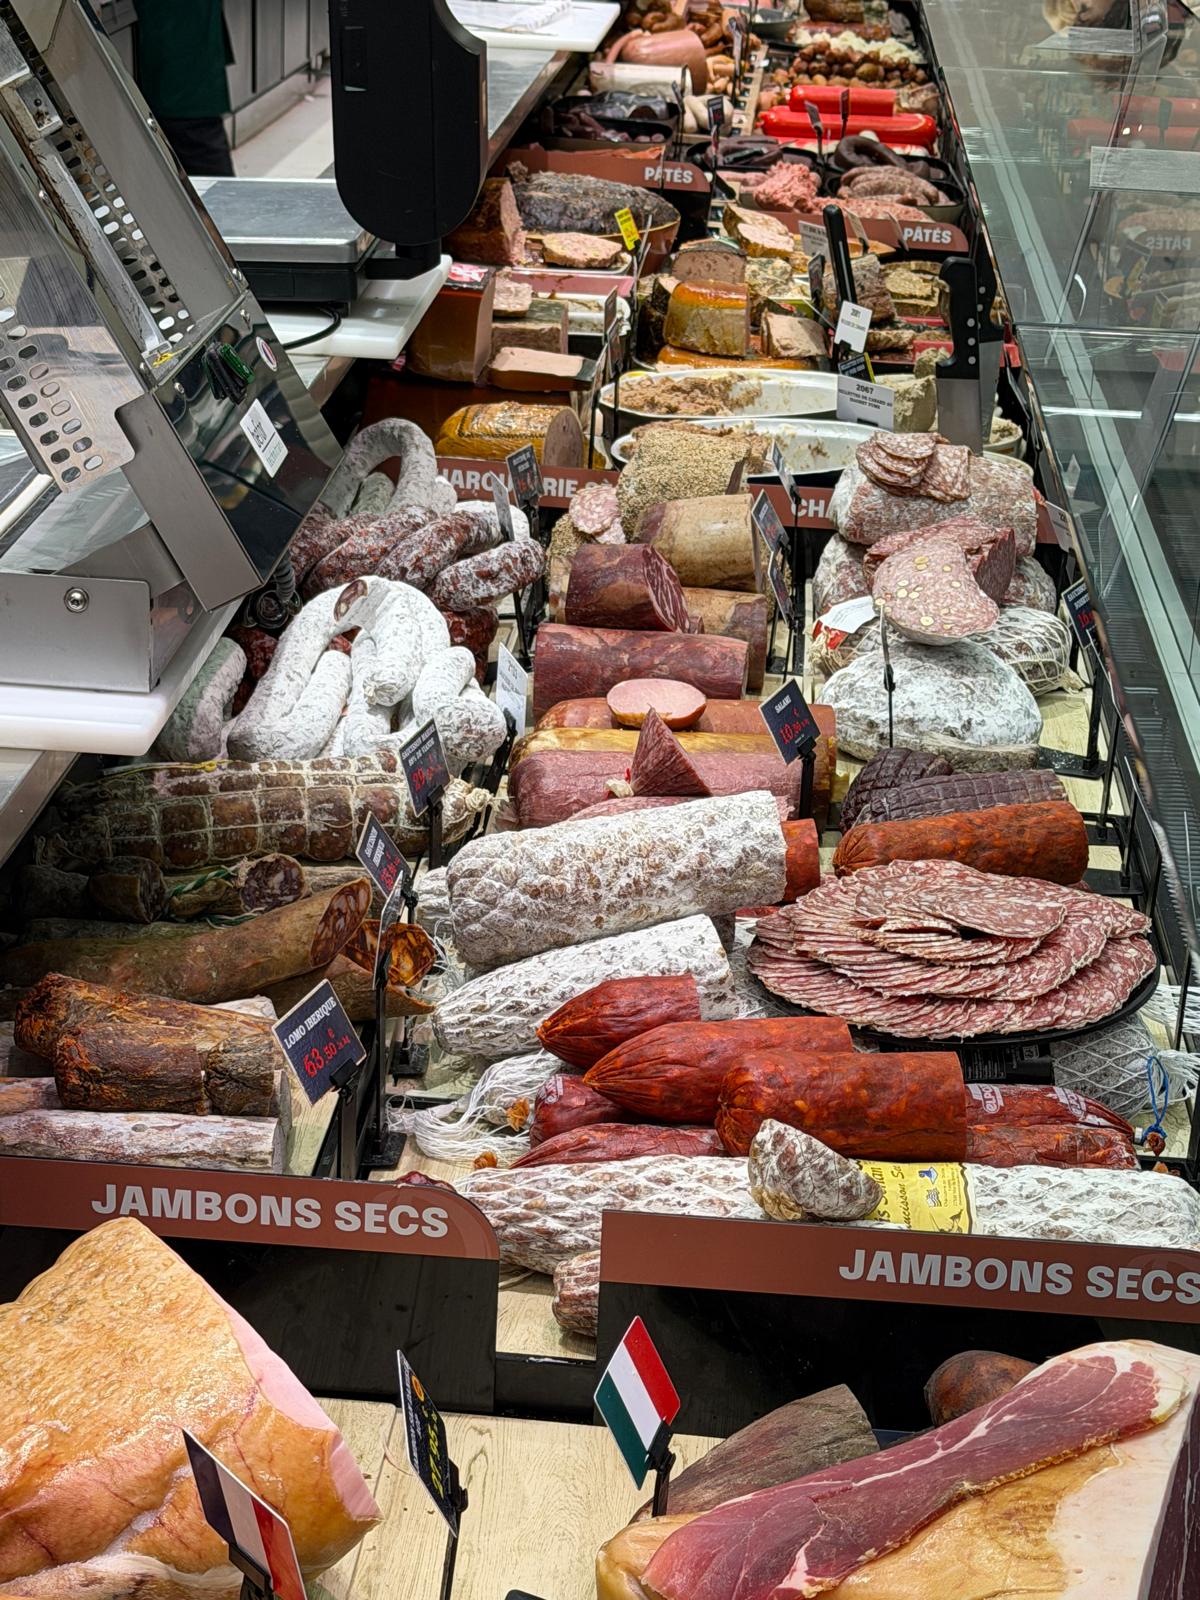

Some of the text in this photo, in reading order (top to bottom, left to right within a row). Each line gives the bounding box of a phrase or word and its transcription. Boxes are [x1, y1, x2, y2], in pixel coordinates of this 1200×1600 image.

[644, 165, 693, 184] PÂTÉS
[903, 225, 952, 244] PÂTÉS
[855, 383, 874, 395] 2067
[774, 694, 792, 714] SALAMI
[283, 1024, 306, 1050] LOMO
[303, 996, 337, 1031] IBERIQUE
[91, 1183, 449, 1238] JAMBONS SECS
[838, 1248, 1200, 1305] JAMBONS SECS
